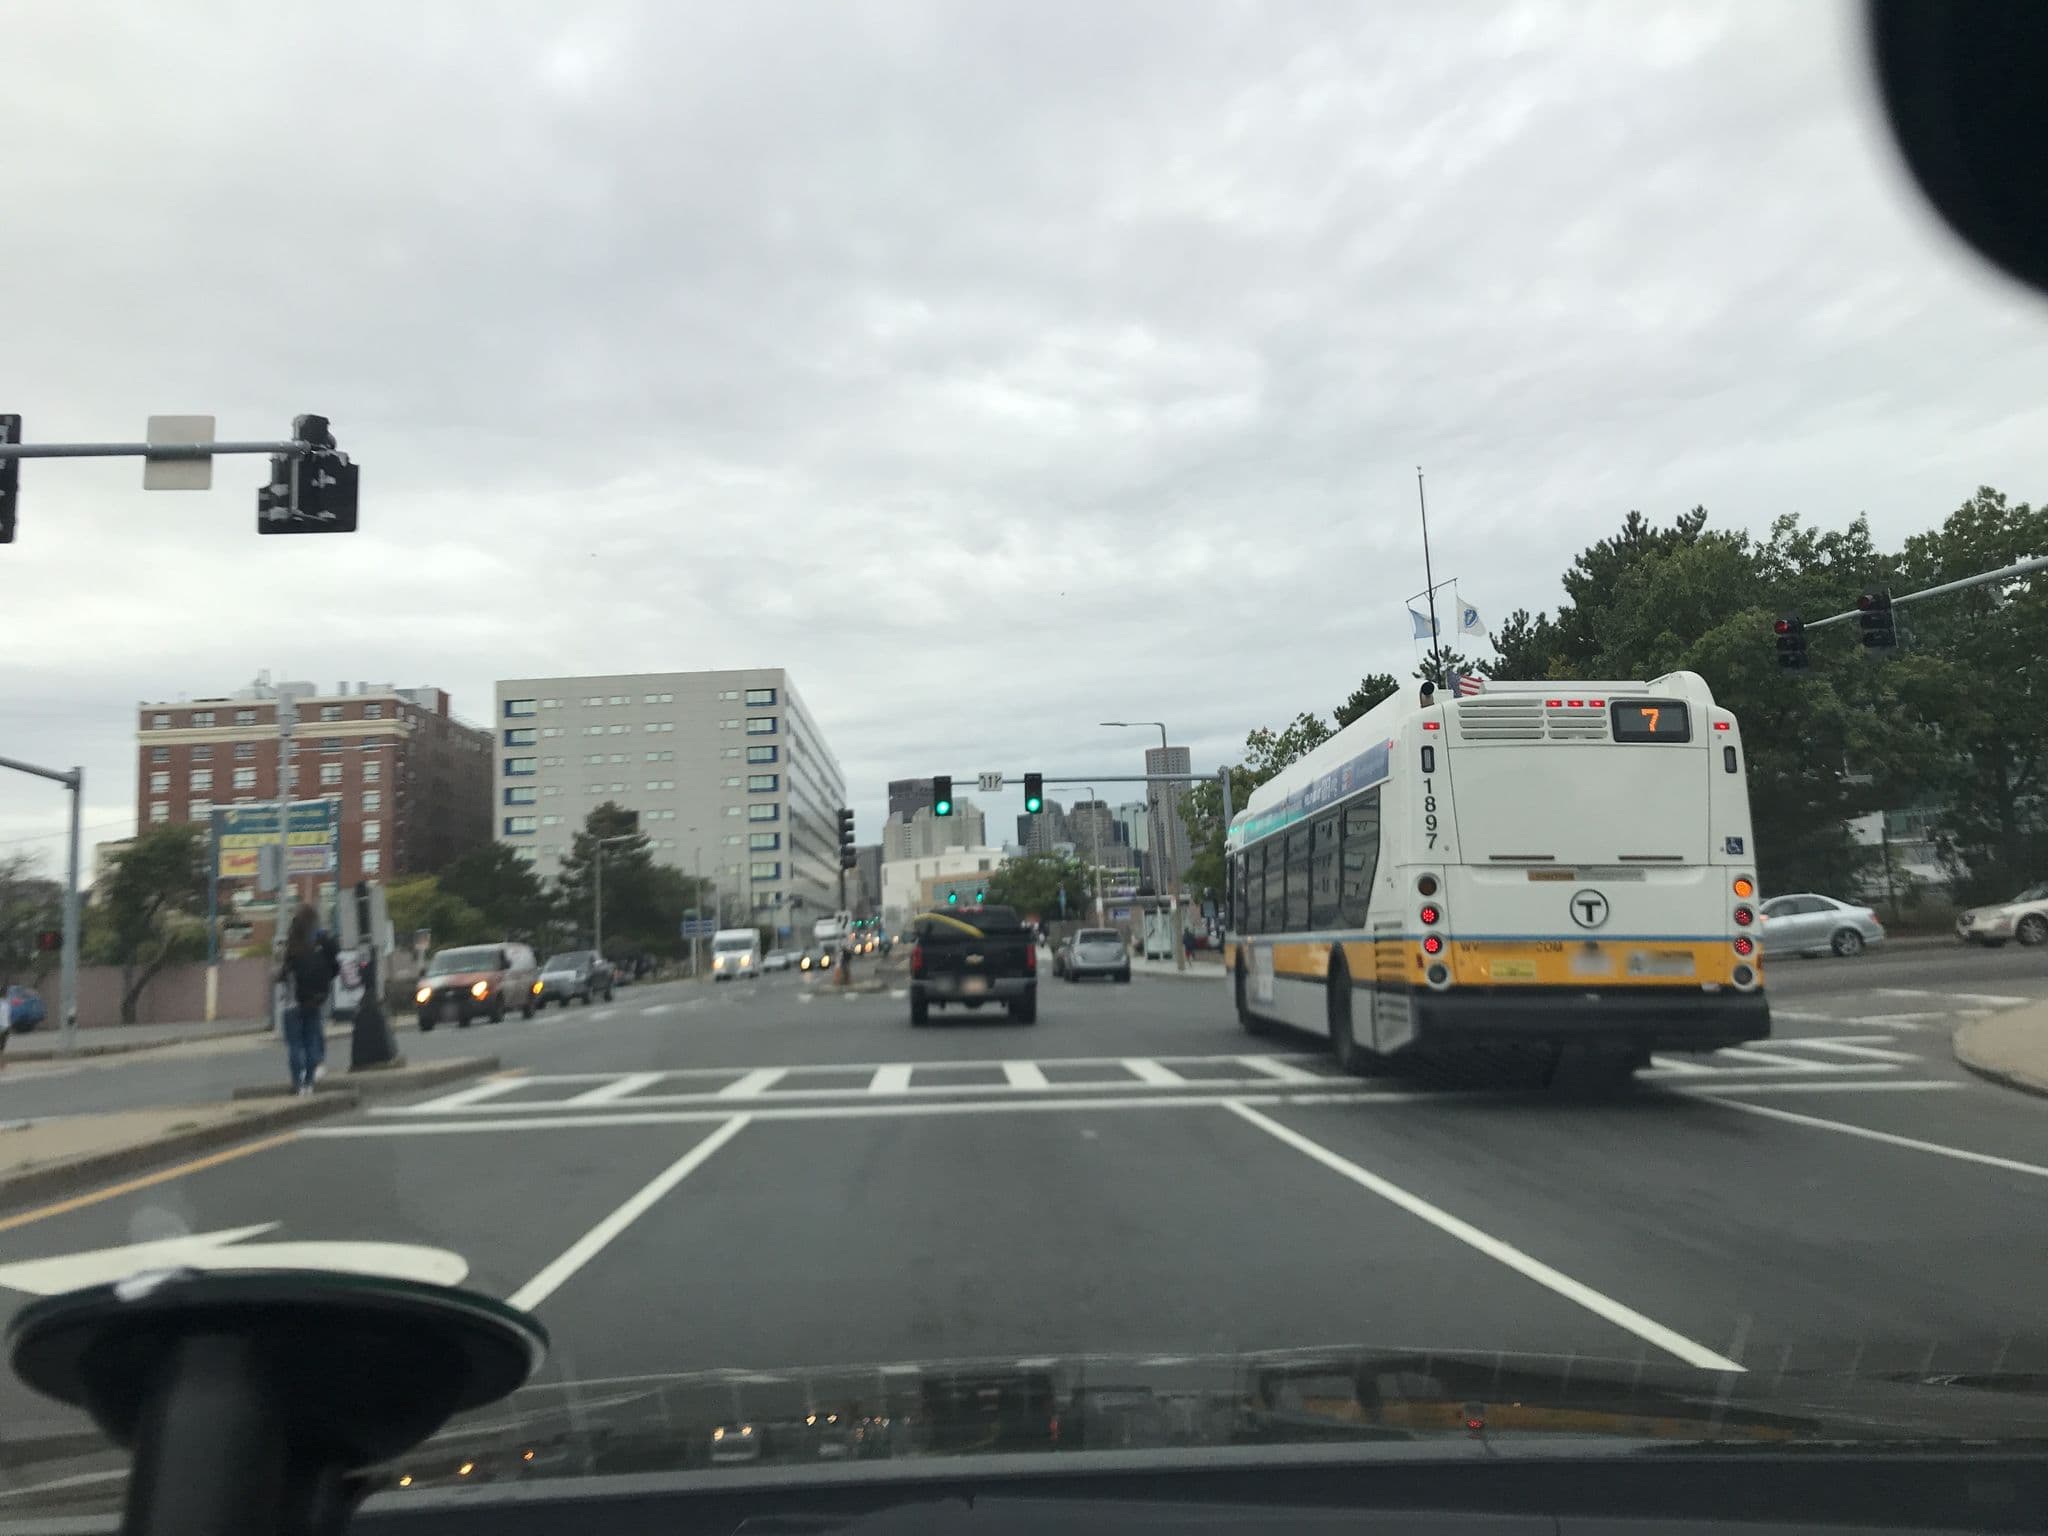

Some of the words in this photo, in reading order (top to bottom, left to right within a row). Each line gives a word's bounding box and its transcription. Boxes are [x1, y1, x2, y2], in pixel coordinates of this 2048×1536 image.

[1640, 707, 1659, 734] 7
[1423, 777, 1437, 849] 1897
[1576, 899, 1601, 922] T
